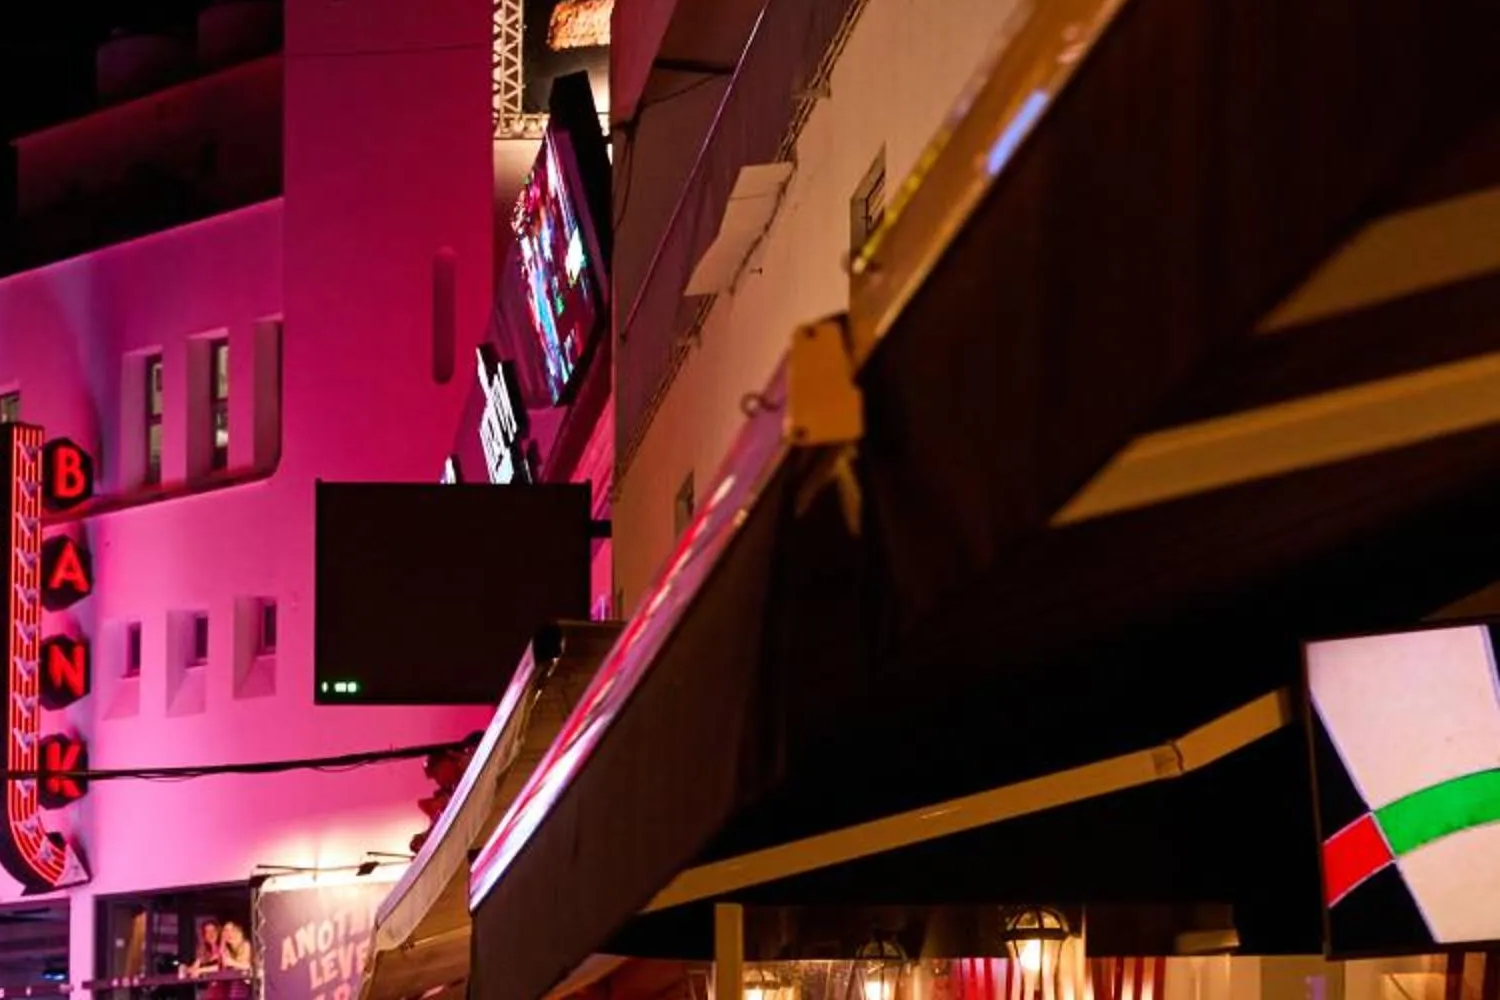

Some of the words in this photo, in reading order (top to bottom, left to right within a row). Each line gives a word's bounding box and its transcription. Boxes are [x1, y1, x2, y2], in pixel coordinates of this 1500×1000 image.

[47, 446, 88, 798] BANK
[280, 908, 372, 971] ANOT
[309, 936, 370, 990] LEVE
